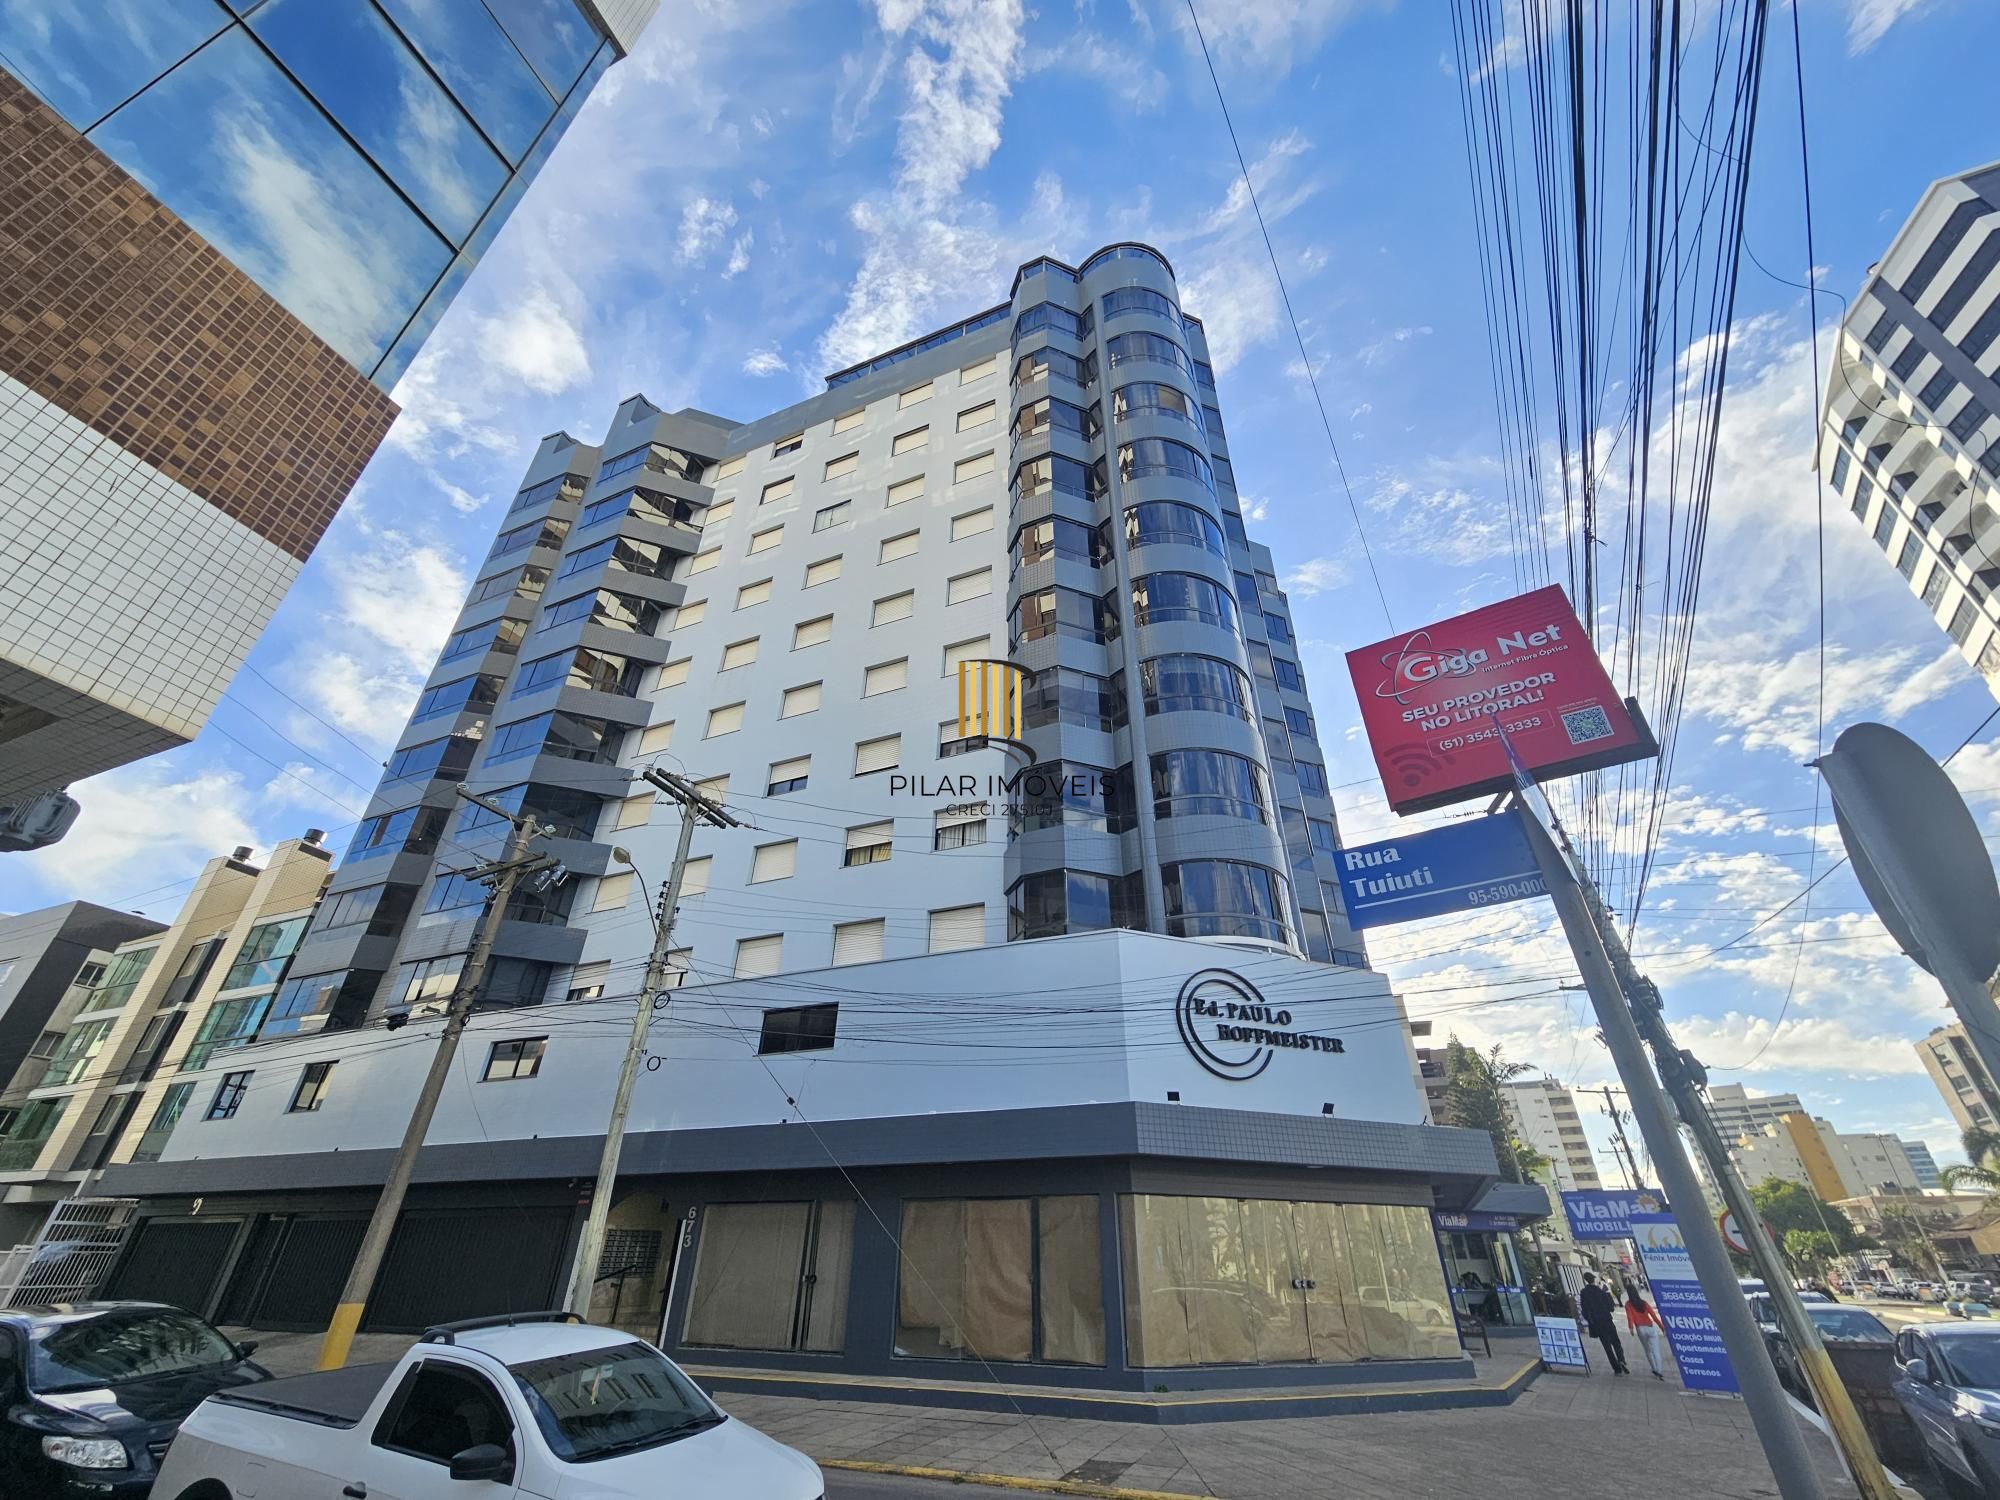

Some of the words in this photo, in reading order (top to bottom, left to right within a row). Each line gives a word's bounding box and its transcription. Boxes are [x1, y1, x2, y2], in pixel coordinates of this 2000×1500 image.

[1404, 648, 1489, 682] Giga
[1497, 624, 1562, 655] Net
[1482, 658, 1517, 672] Internet
[1517, 653, 1538, 663] Fibra
[1540, 645, 1568, 656] Óptica
[1402, 704, 1438, 722] SEU
[1443, 672, 1556, 711] PROVEDOR
[1421, 715, 1451, 731] NO
[1454, 689, 1544, 722] LITORAL!
[1440, 736, 1464, 751] (51)
[1467, 717, 1541, 743] 3543-3333
[1344, 847, 1401, 871] Rua
[1349, 866, 1433, 898] Tuiuti
[1193, 998, 1224, 1018] Ed.
[1226, 1002, 1292, 1026] PAULO
[1216, 1023, 1346, 1053] HOFFMEISTER
[1576, 1221, 1632, 1232] IMOBILI
[1680, 1355, 1704, 1364] Casas
[1683, 1366, 1721, 1377] Terrenos
